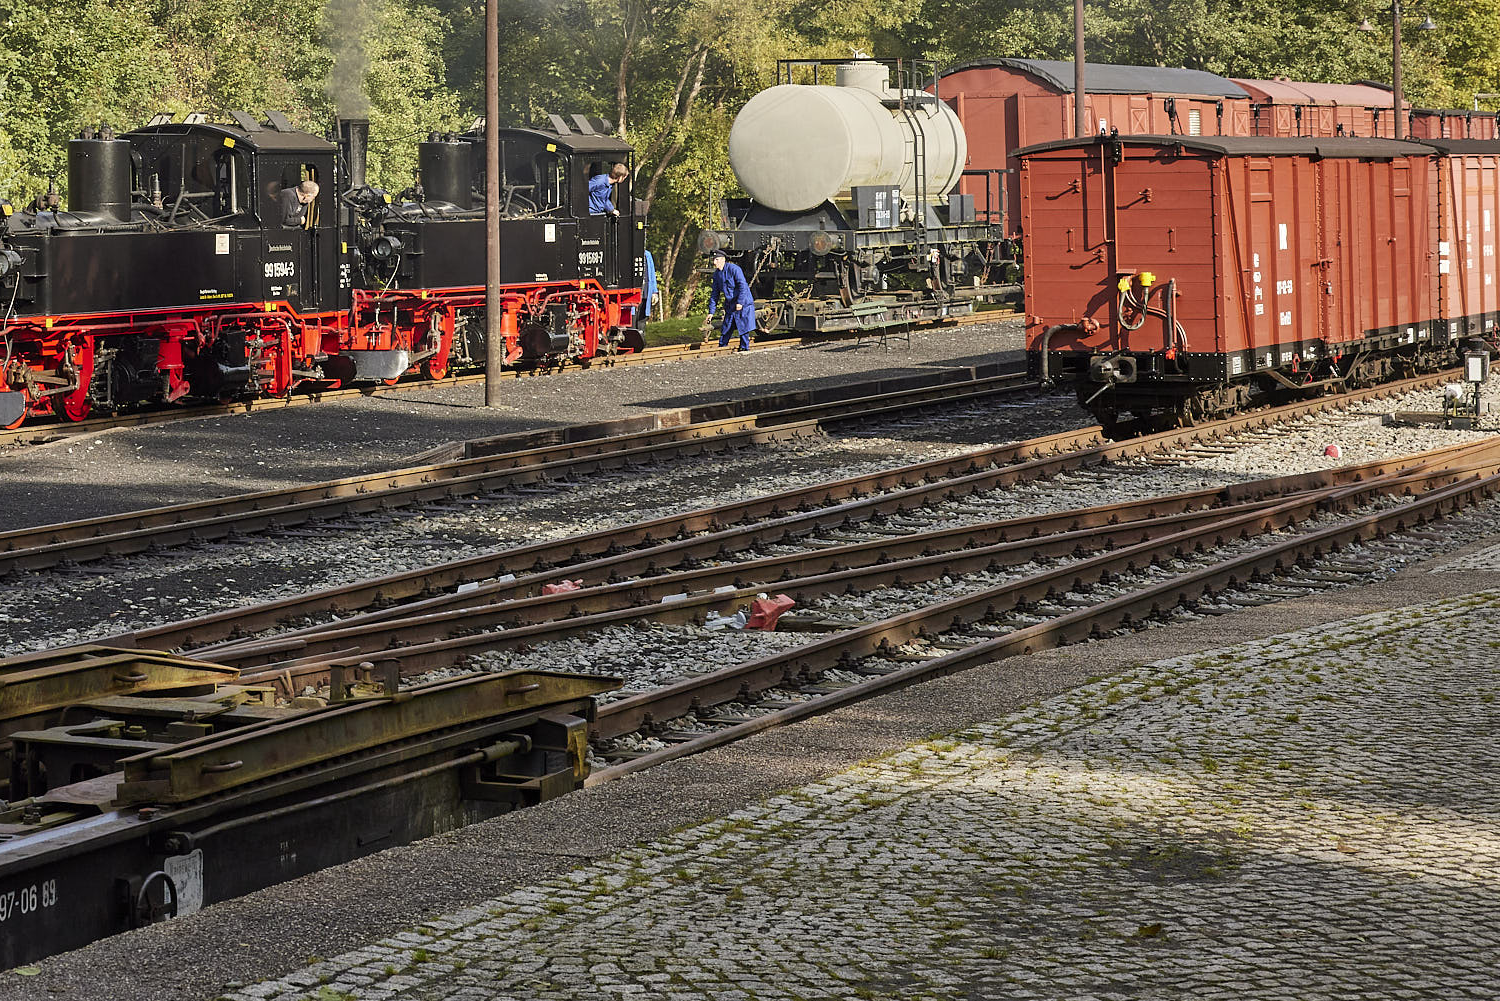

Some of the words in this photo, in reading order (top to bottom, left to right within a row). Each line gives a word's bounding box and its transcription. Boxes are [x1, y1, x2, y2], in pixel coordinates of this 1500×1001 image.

[264, 262, 274, 277] 99
[274, 261, 294, 277] 1594-3
[0, 884, 37, 922] 97-06
